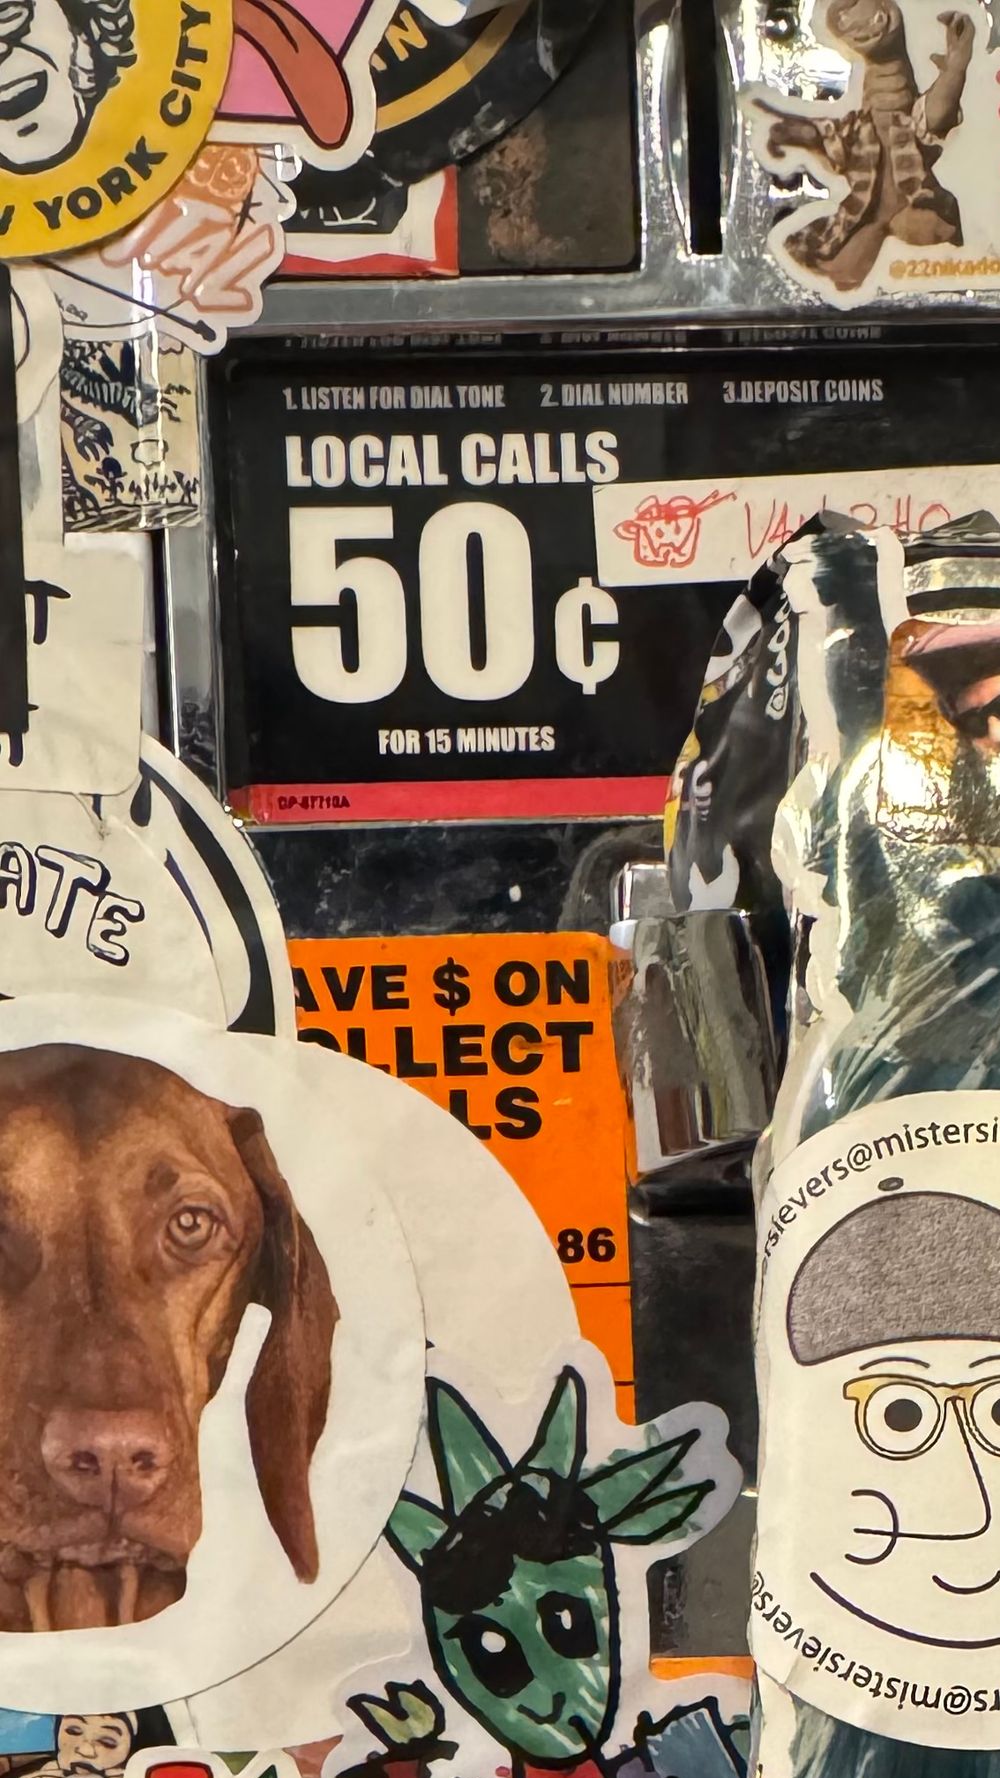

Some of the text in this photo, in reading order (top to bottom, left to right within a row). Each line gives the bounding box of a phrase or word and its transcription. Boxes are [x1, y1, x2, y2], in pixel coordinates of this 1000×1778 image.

[33, 135, 168, 230] YORK
[160, 1, 211, 127] CITY
[301, 386, 365, 410] LISTEN
[370, 386, 405, 409] FOR
[410, 385, 453, 409] DIAL
[457, 384, 505, 408] TONE
[561, 384, 604, 406] DIAL
[608, 382, 688, 406] NUMBER
[824, 379, 883, 401] COINS
[286, 431, 619, 488] LOCAL CALLS
[378, 725, 555, 755] FOR 15 MINUTES
[433, 957, 471, 1016] $
[494, 959, 590, 1007] ON
